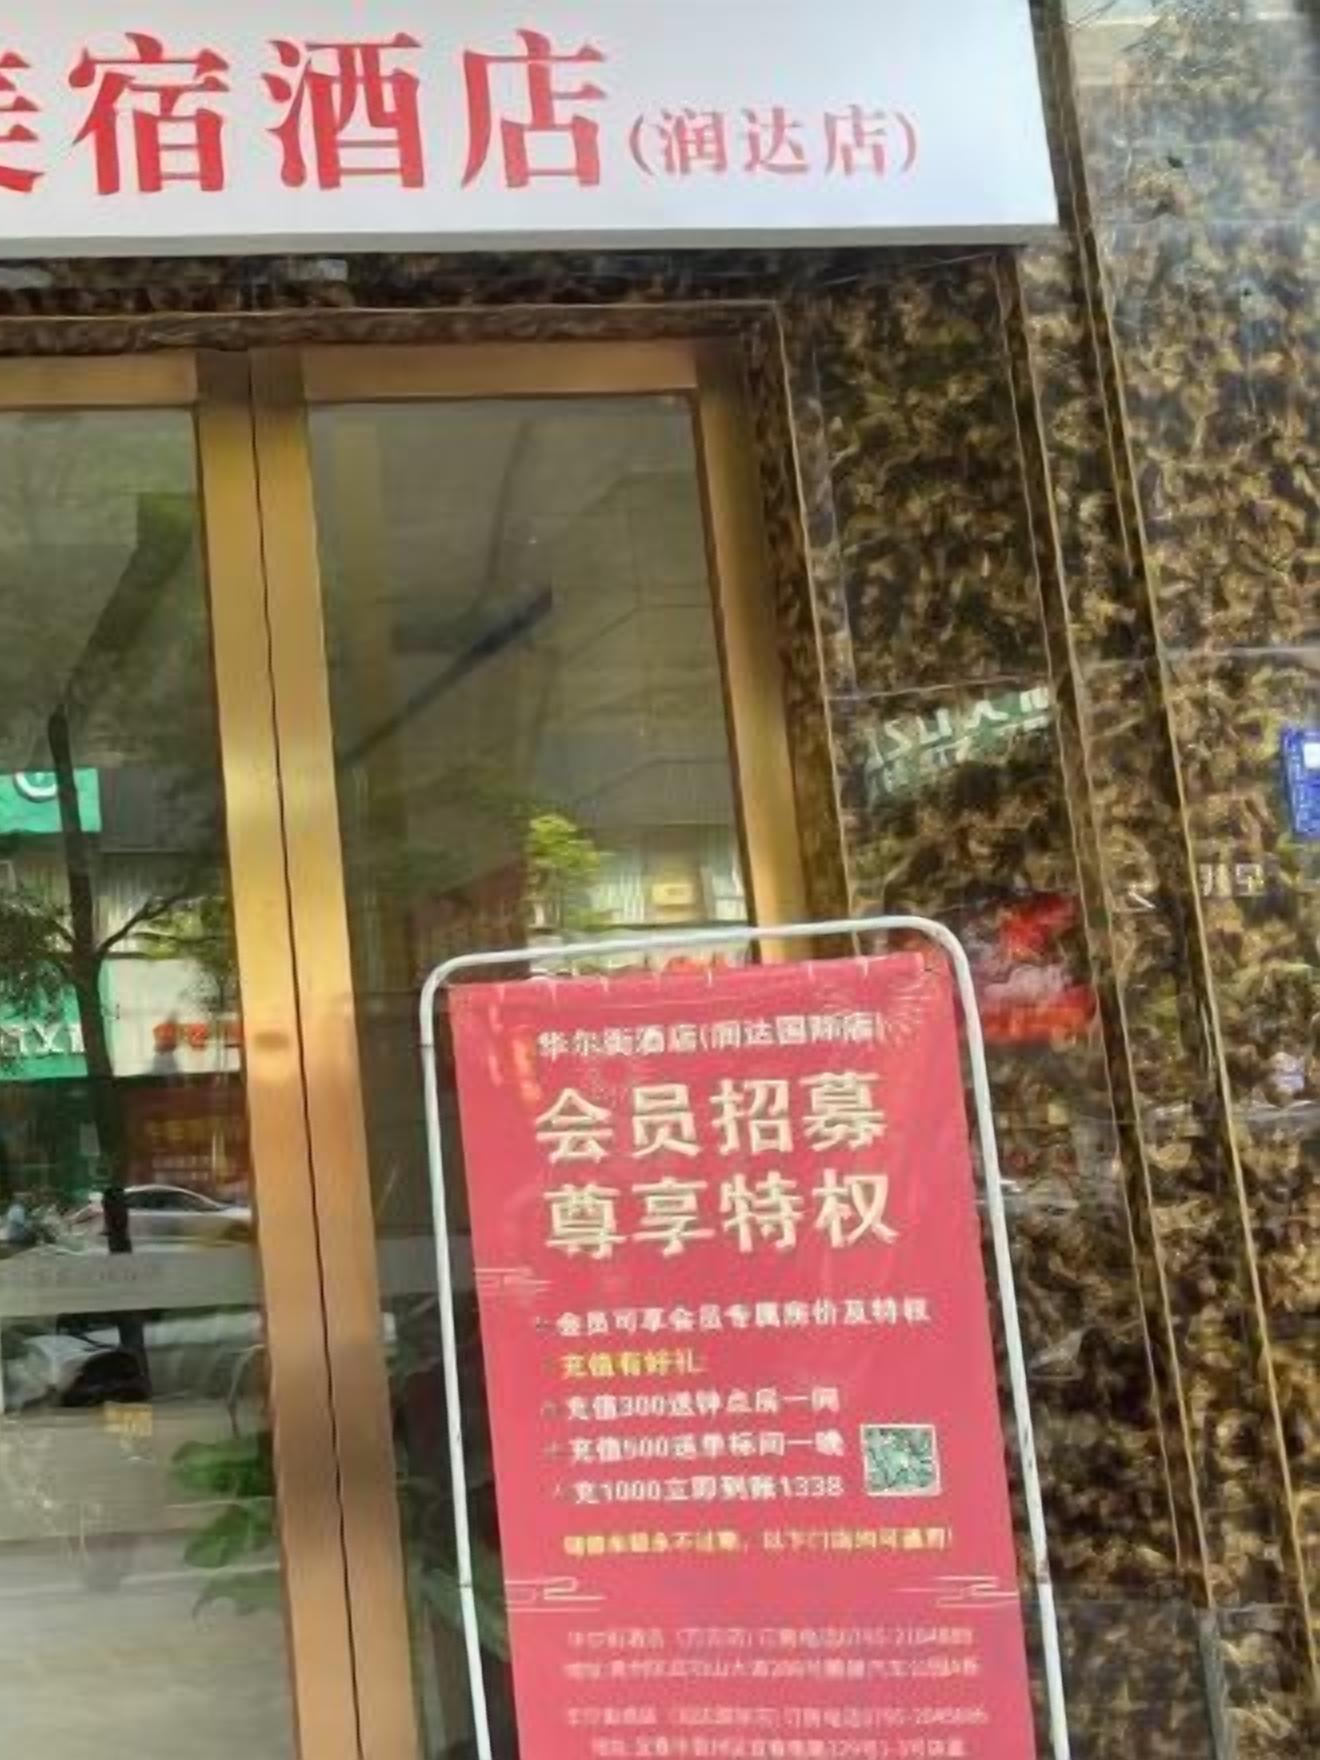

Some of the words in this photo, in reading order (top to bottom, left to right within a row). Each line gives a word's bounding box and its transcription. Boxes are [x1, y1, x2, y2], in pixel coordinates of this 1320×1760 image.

[628, 104, 919, 177] (润达店)
[534, 1070, 888, 1164] 会员招募
[543, 1167, 899, 1261] 尊享特权
[561, 1348, 706, 1379] 充值有好礼
